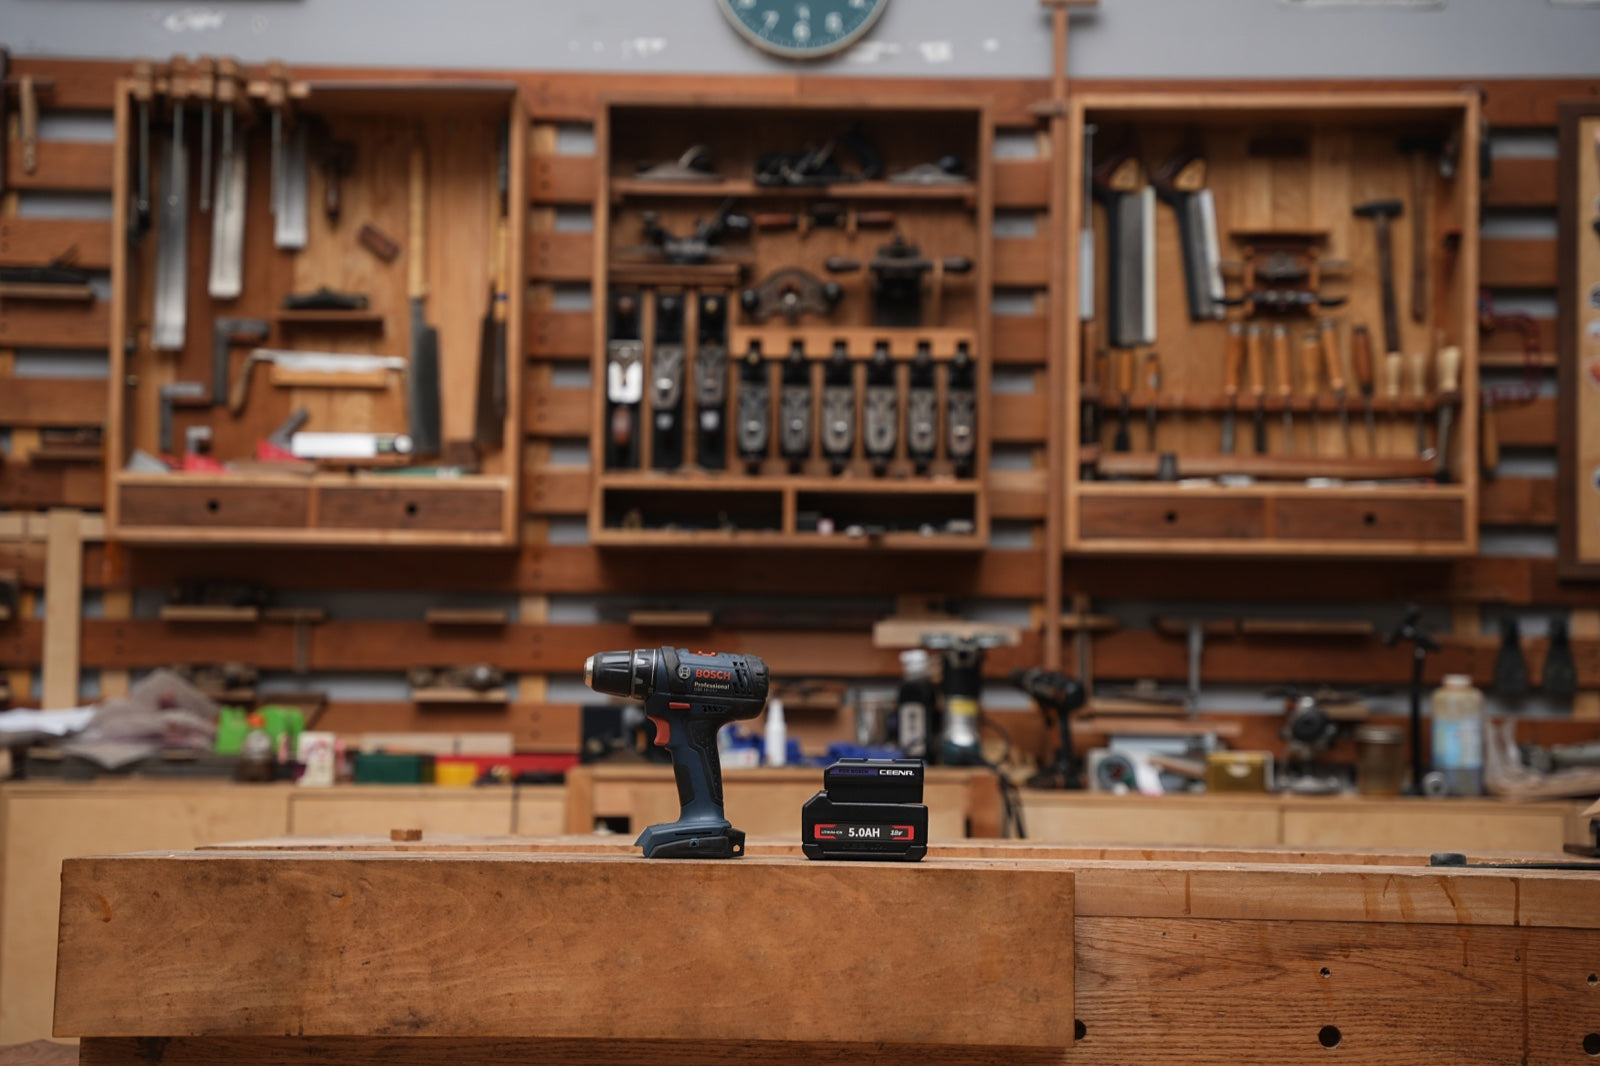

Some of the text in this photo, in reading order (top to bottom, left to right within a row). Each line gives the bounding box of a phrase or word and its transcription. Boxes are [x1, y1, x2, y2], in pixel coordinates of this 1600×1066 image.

[695, 669, 731, 680] BOSCH
[694, 681, 730, 690] Professional
[848, 828, 880, 838] 5.0AH
